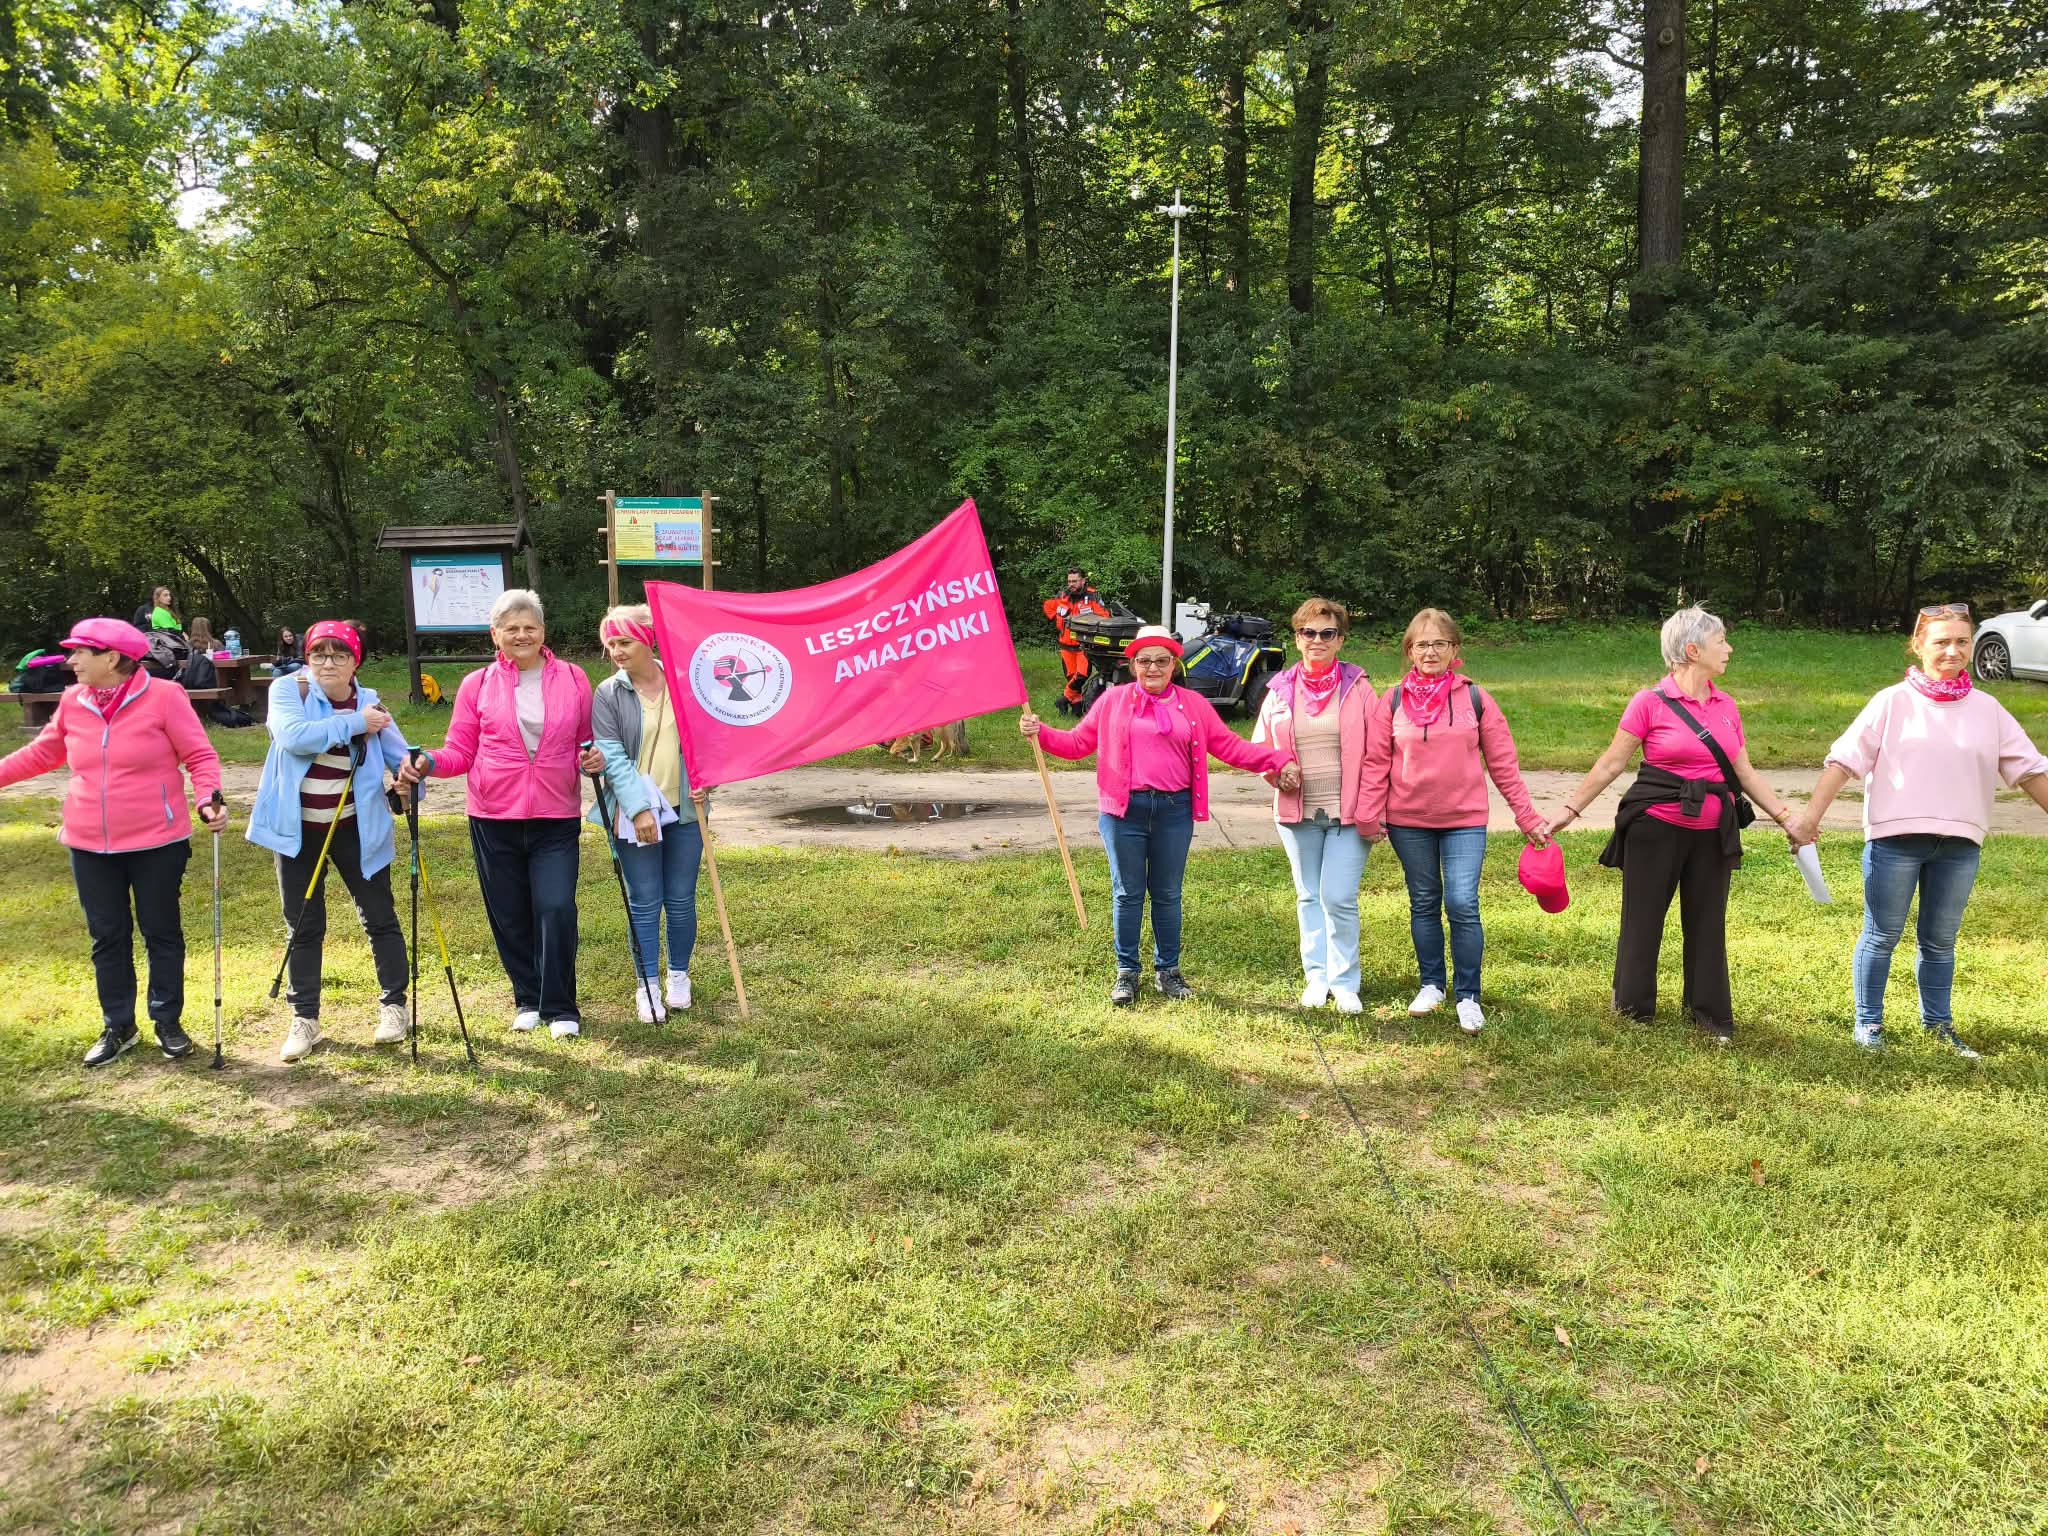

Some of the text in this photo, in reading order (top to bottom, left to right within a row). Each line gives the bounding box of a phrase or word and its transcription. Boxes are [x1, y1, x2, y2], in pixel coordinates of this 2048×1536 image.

[805, 570, 996, 656] LESZCZYŃSKI
[701, 635, 766, 656] AMAZONKA
[834, 610, 990, 683] AMAZONKI
[714, 706, 771, 720] STOWARZYSZENIE
